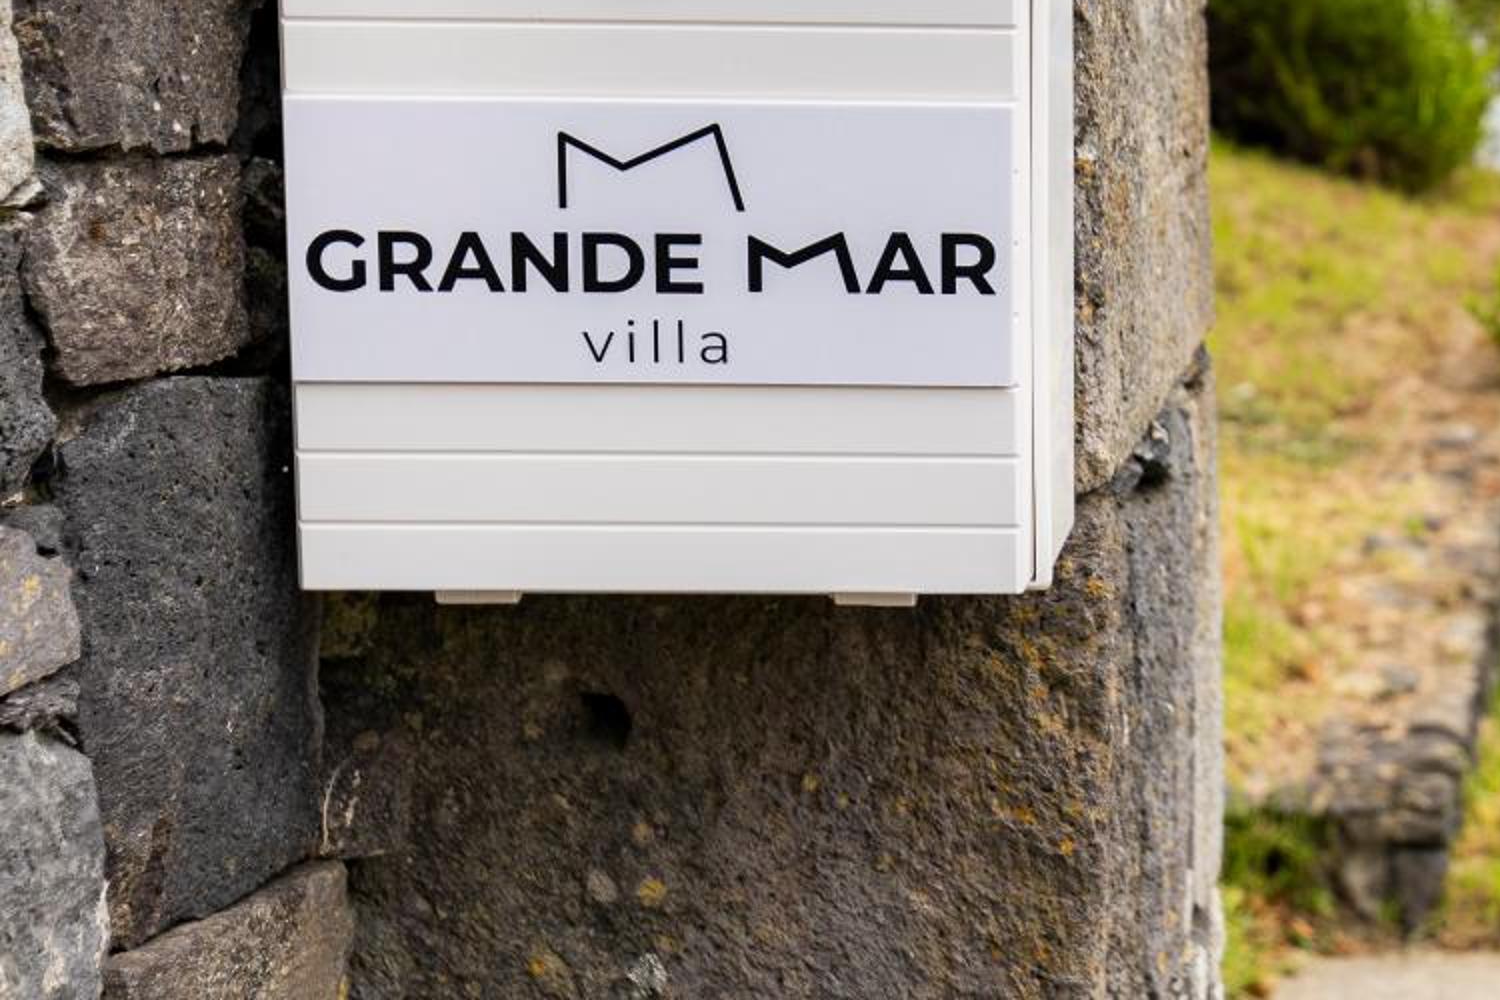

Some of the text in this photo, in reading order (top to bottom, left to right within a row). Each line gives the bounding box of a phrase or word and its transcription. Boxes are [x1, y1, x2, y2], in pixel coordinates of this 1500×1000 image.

[305, 229, 996, 296] GRANDE MAR
[582, 319, 728, 365] villa
